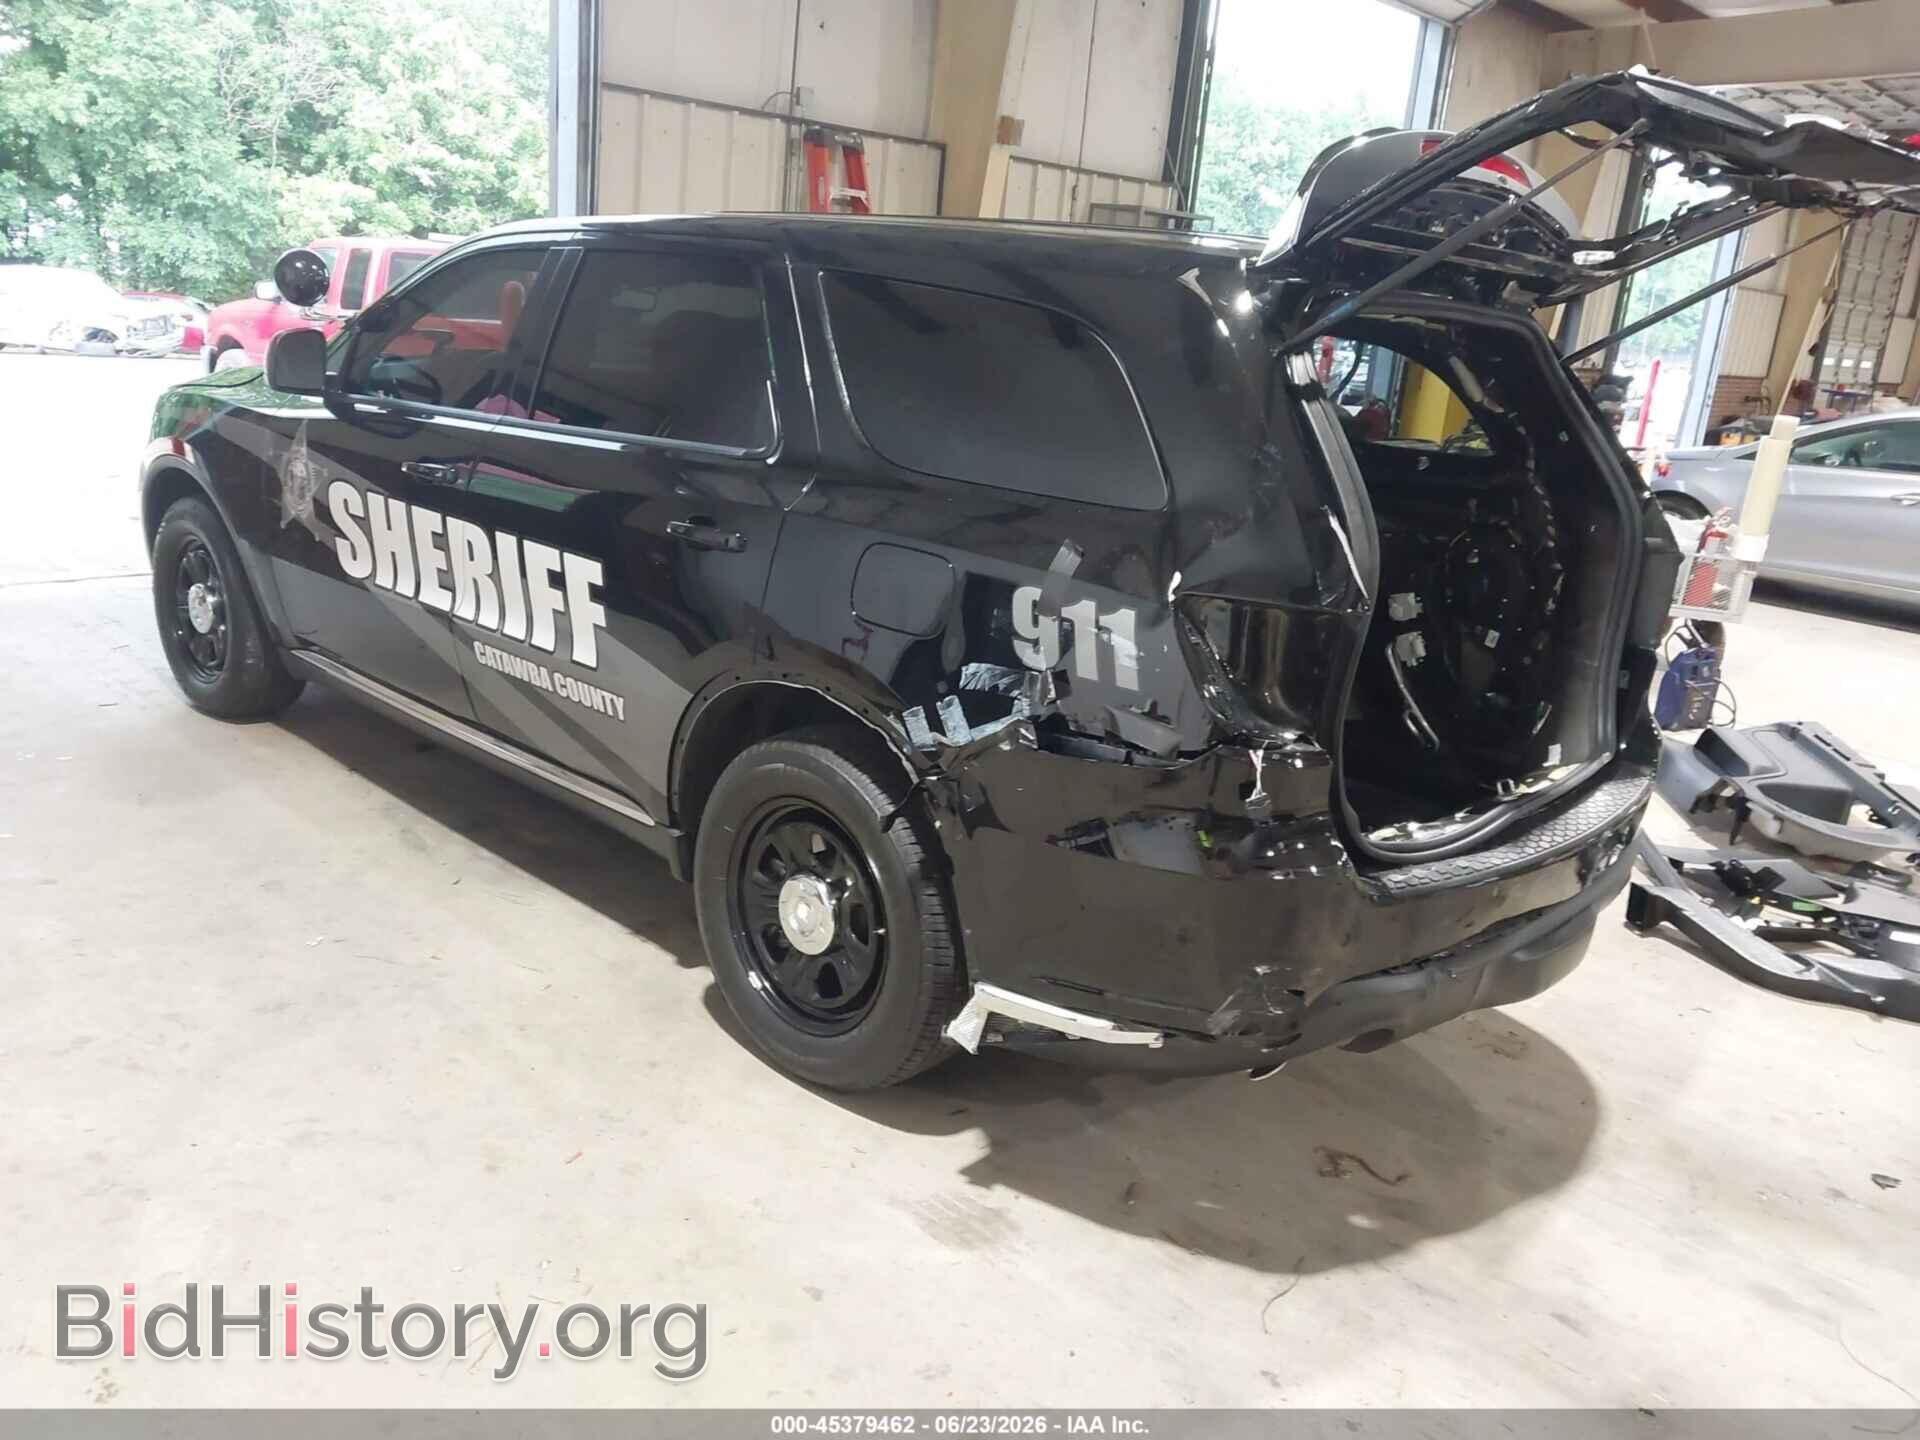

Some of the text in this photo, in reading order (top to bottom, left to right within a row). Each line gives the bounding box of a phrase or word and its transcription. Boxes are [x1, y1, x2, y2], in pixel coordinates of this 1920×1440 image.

[328, 481, 607, 669] SHERIFF
[473, 641, 625, 721] CATAWBA COUNTY
[1012, 586, 1139, 691] 911
